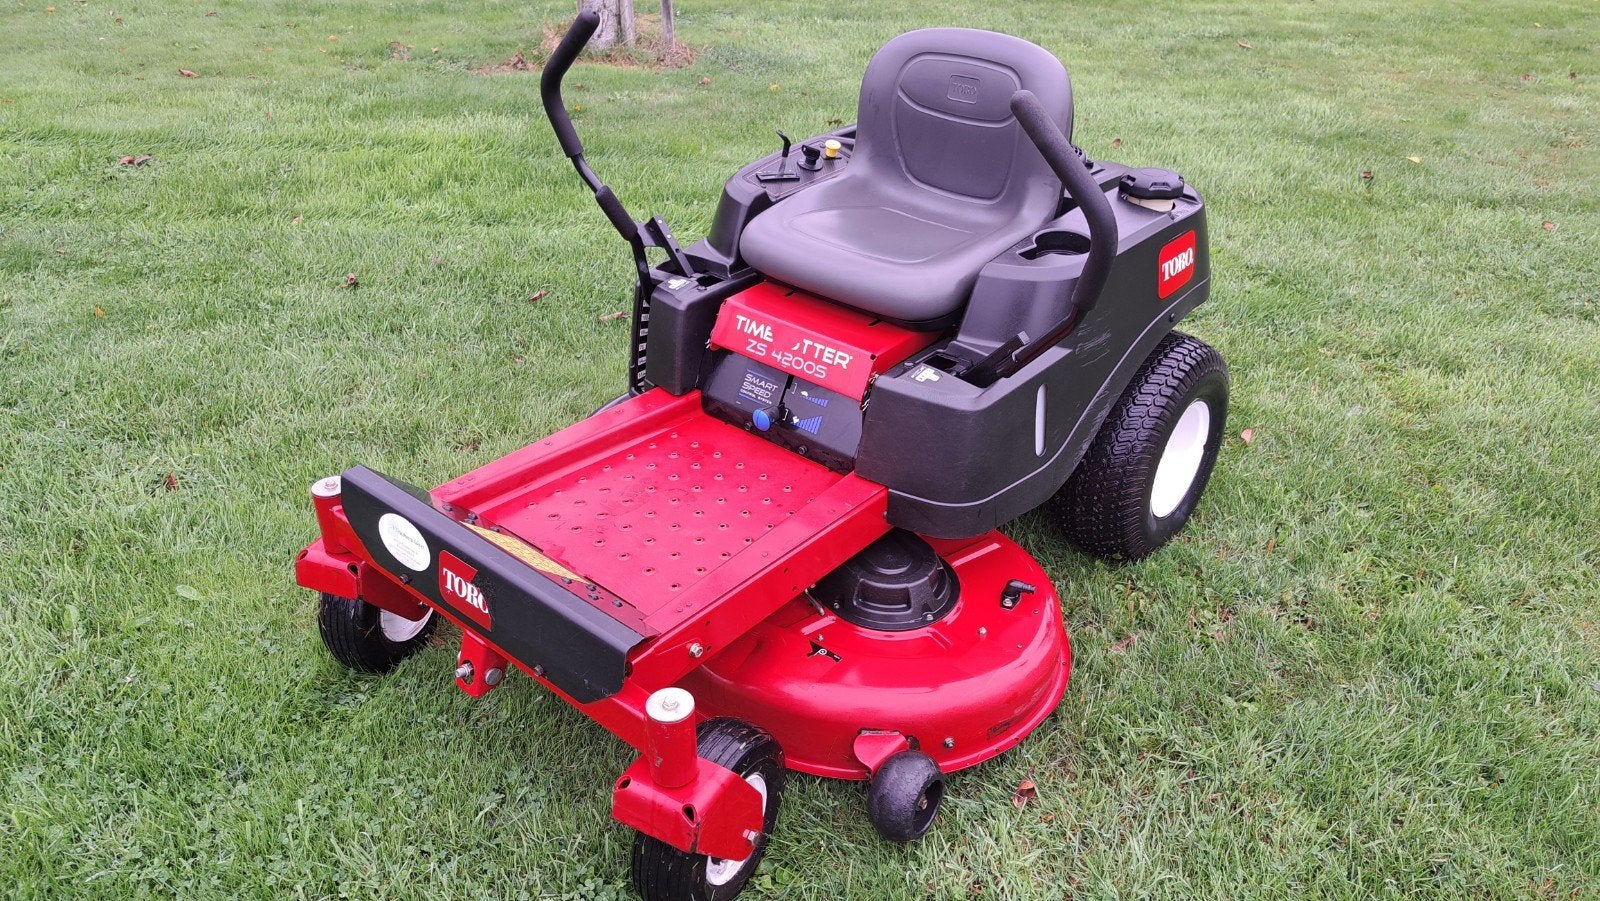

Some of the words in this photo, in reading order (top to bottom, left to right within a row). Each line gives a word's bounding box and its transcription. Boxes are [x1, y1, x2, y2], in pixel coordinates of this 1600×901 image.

[1161, 247, 1194, 282] TORO
[746, 338, 767, 357] ZS
[771, 349, 827, 379] 4200S
[741, 381, 771, 398] SPEED
[745, 373, 778, 391] SMART
